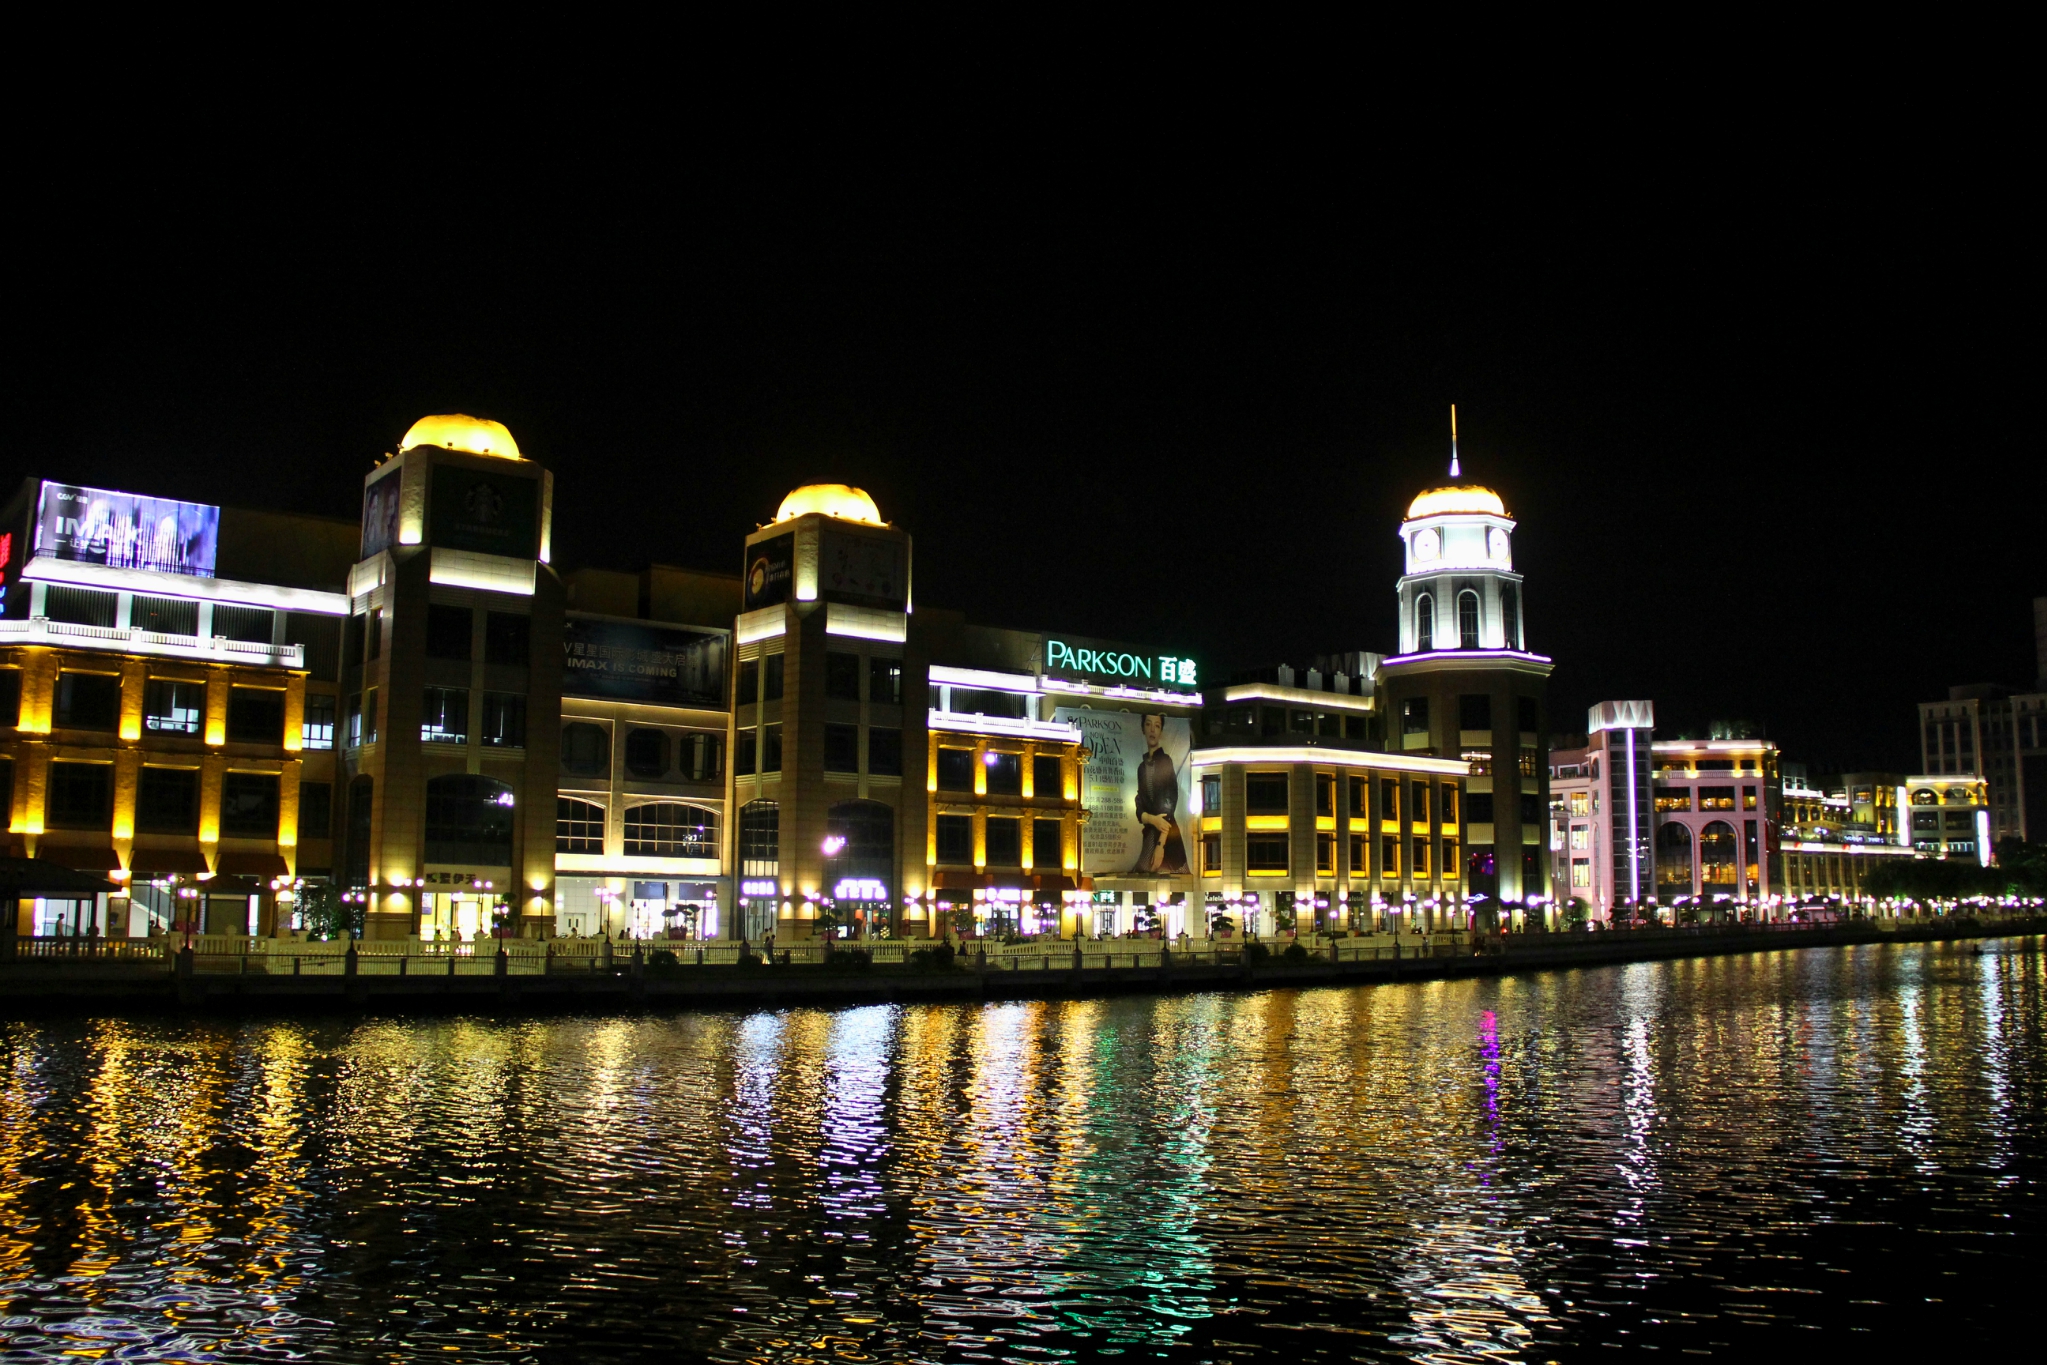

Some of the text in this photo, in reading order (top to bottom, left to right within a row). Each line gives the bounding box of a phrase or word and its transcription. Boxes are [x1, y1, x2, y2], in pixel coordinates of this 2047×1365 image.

[567, 657, 678, 679] IMAX IS COMING
[1048, 640, 1198, 685] PARKSON 百盛
[1079, 716, 1122, 731] PARKSON
